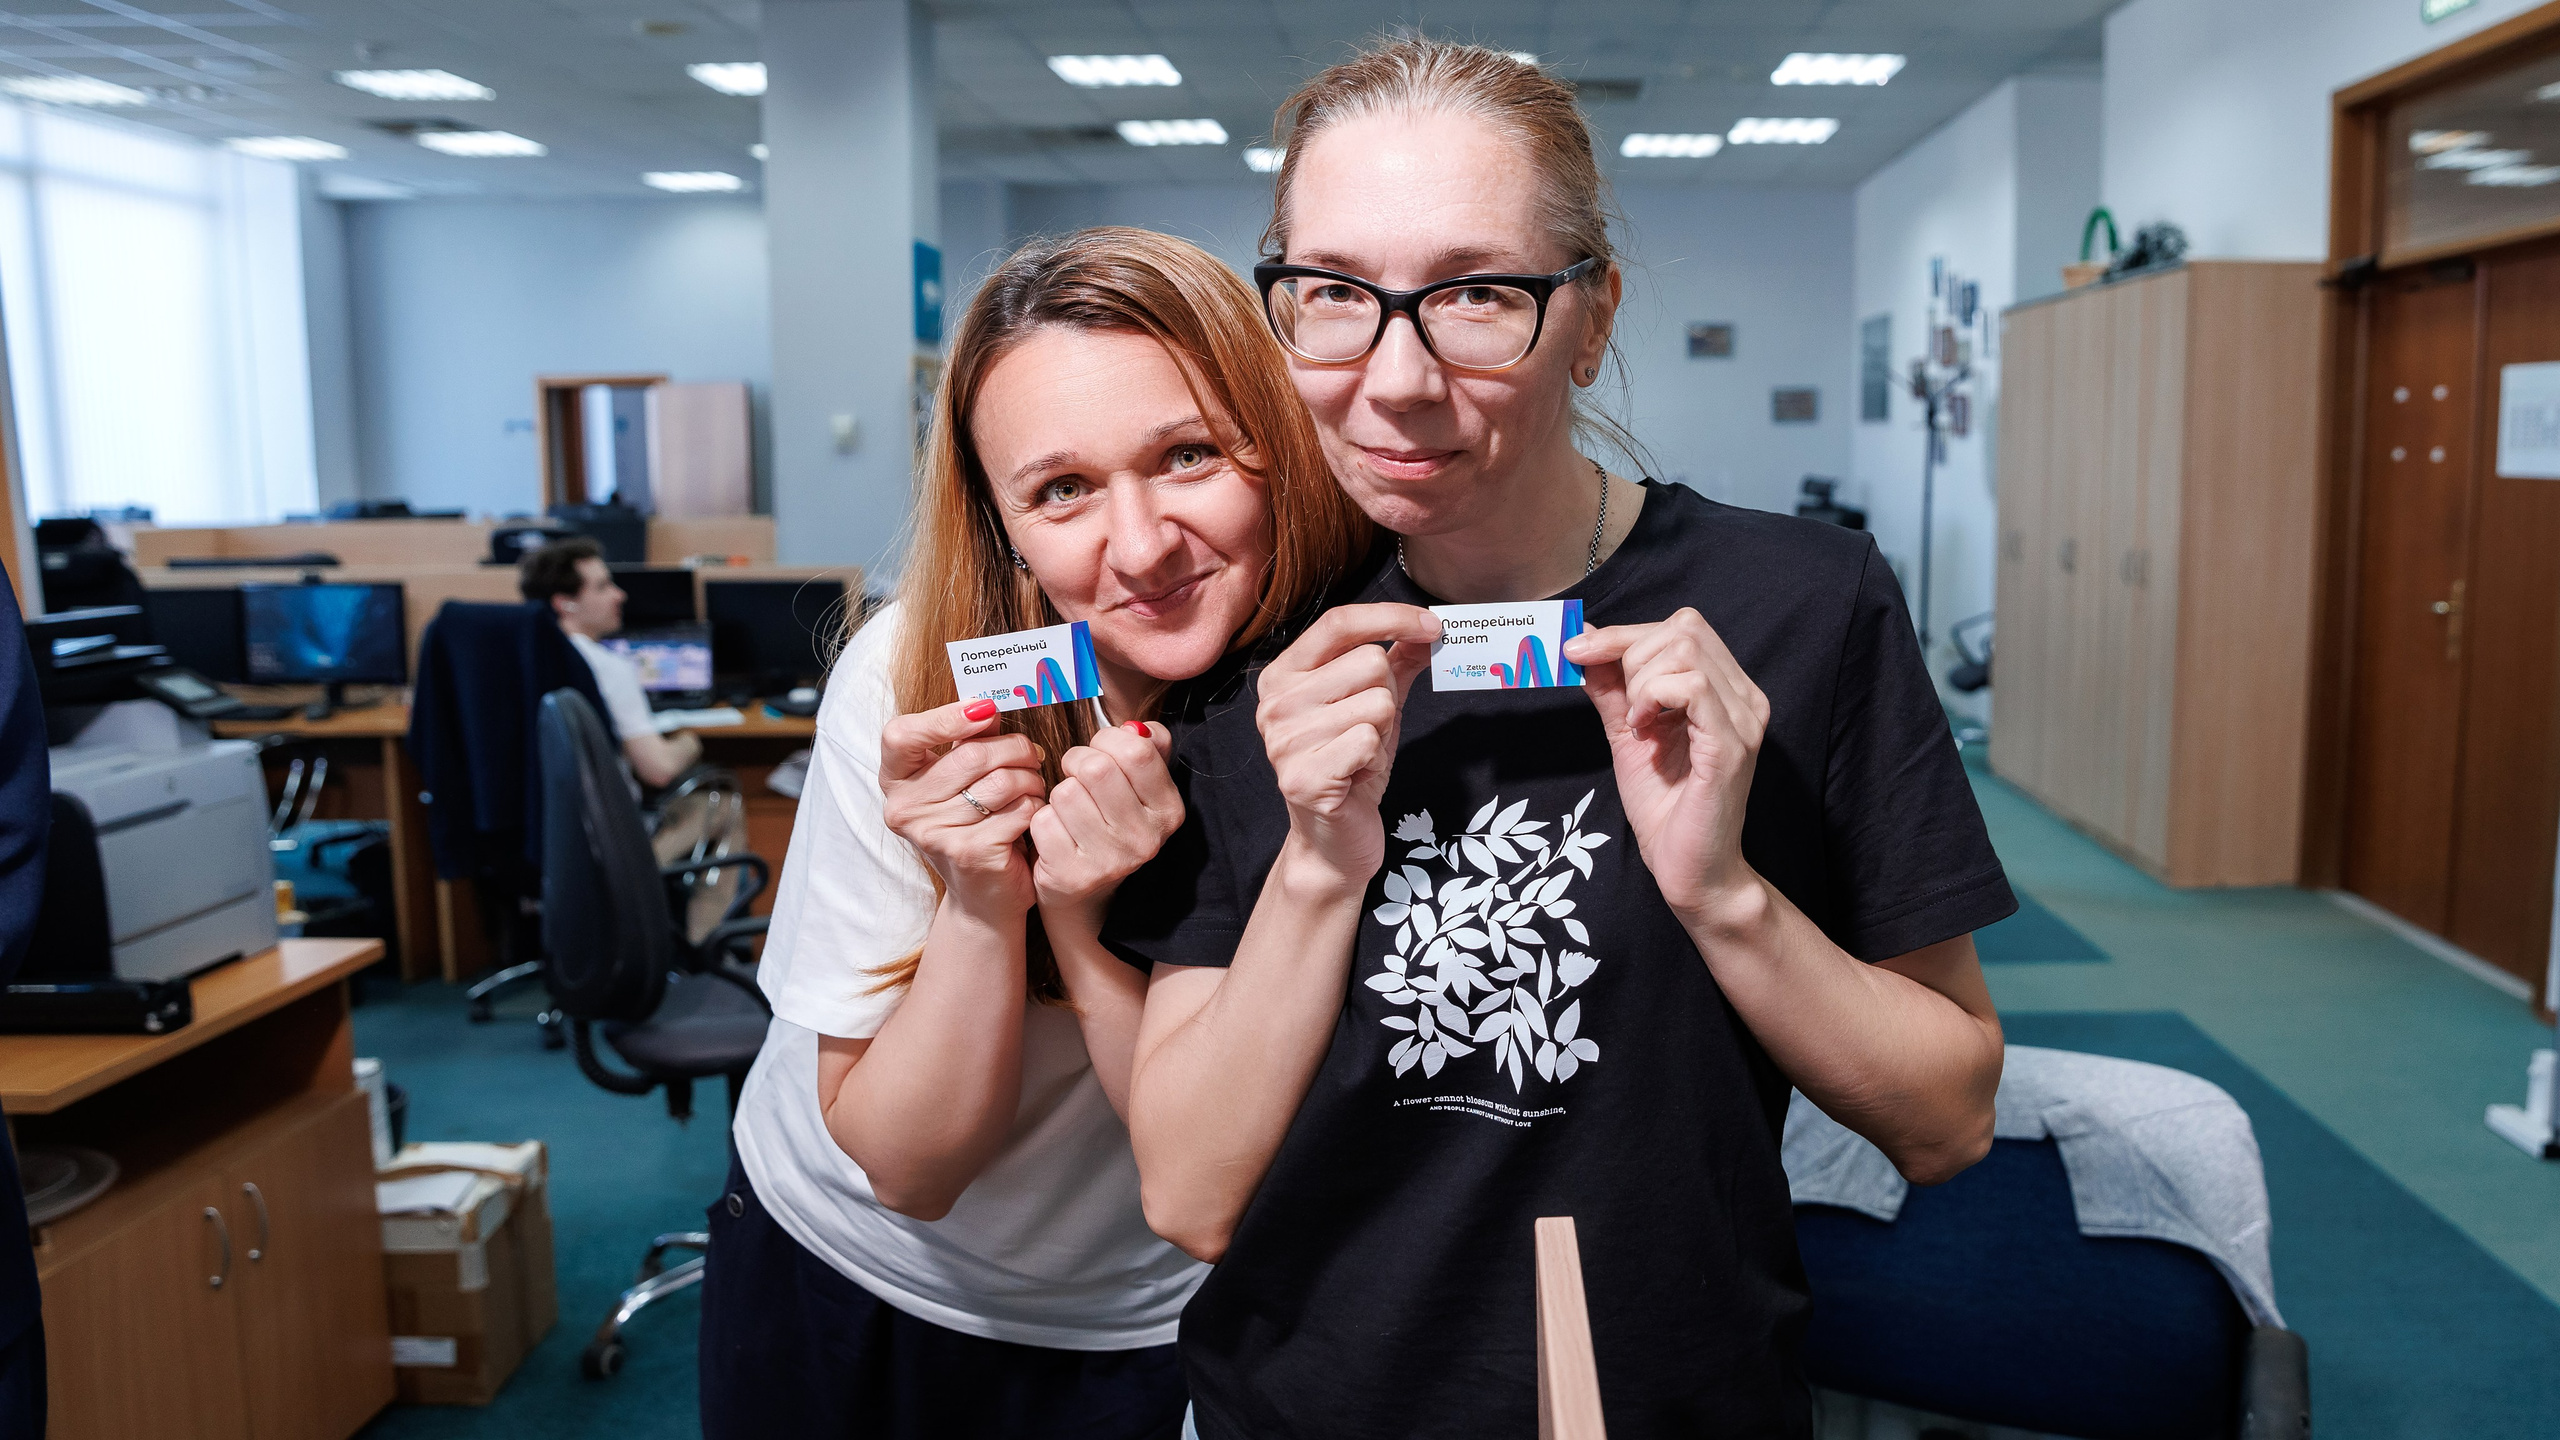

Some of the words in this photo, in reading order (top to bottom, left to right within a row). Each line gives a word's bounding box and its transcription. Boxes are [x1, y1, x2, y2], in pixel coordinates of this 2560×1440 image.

[1441, 615, 1535, 630] Лотерейный
[1441, 634, 1489, 645] билет
[960, 640, 1048, 662] Лотерейный
[963, 662, 1008, 675] билет
[1402, 1097, 1432, 1105] flower
[1465, 1095, 1494, 1109] blossom
[1495, 1102, 1521, 1117] without
[1522, 1107, 1567, 1118] sunshine,
[1466, 1107, 1485, 1117] CANNOT
[1494, 1115, 1514, 1126] WITHOUT
